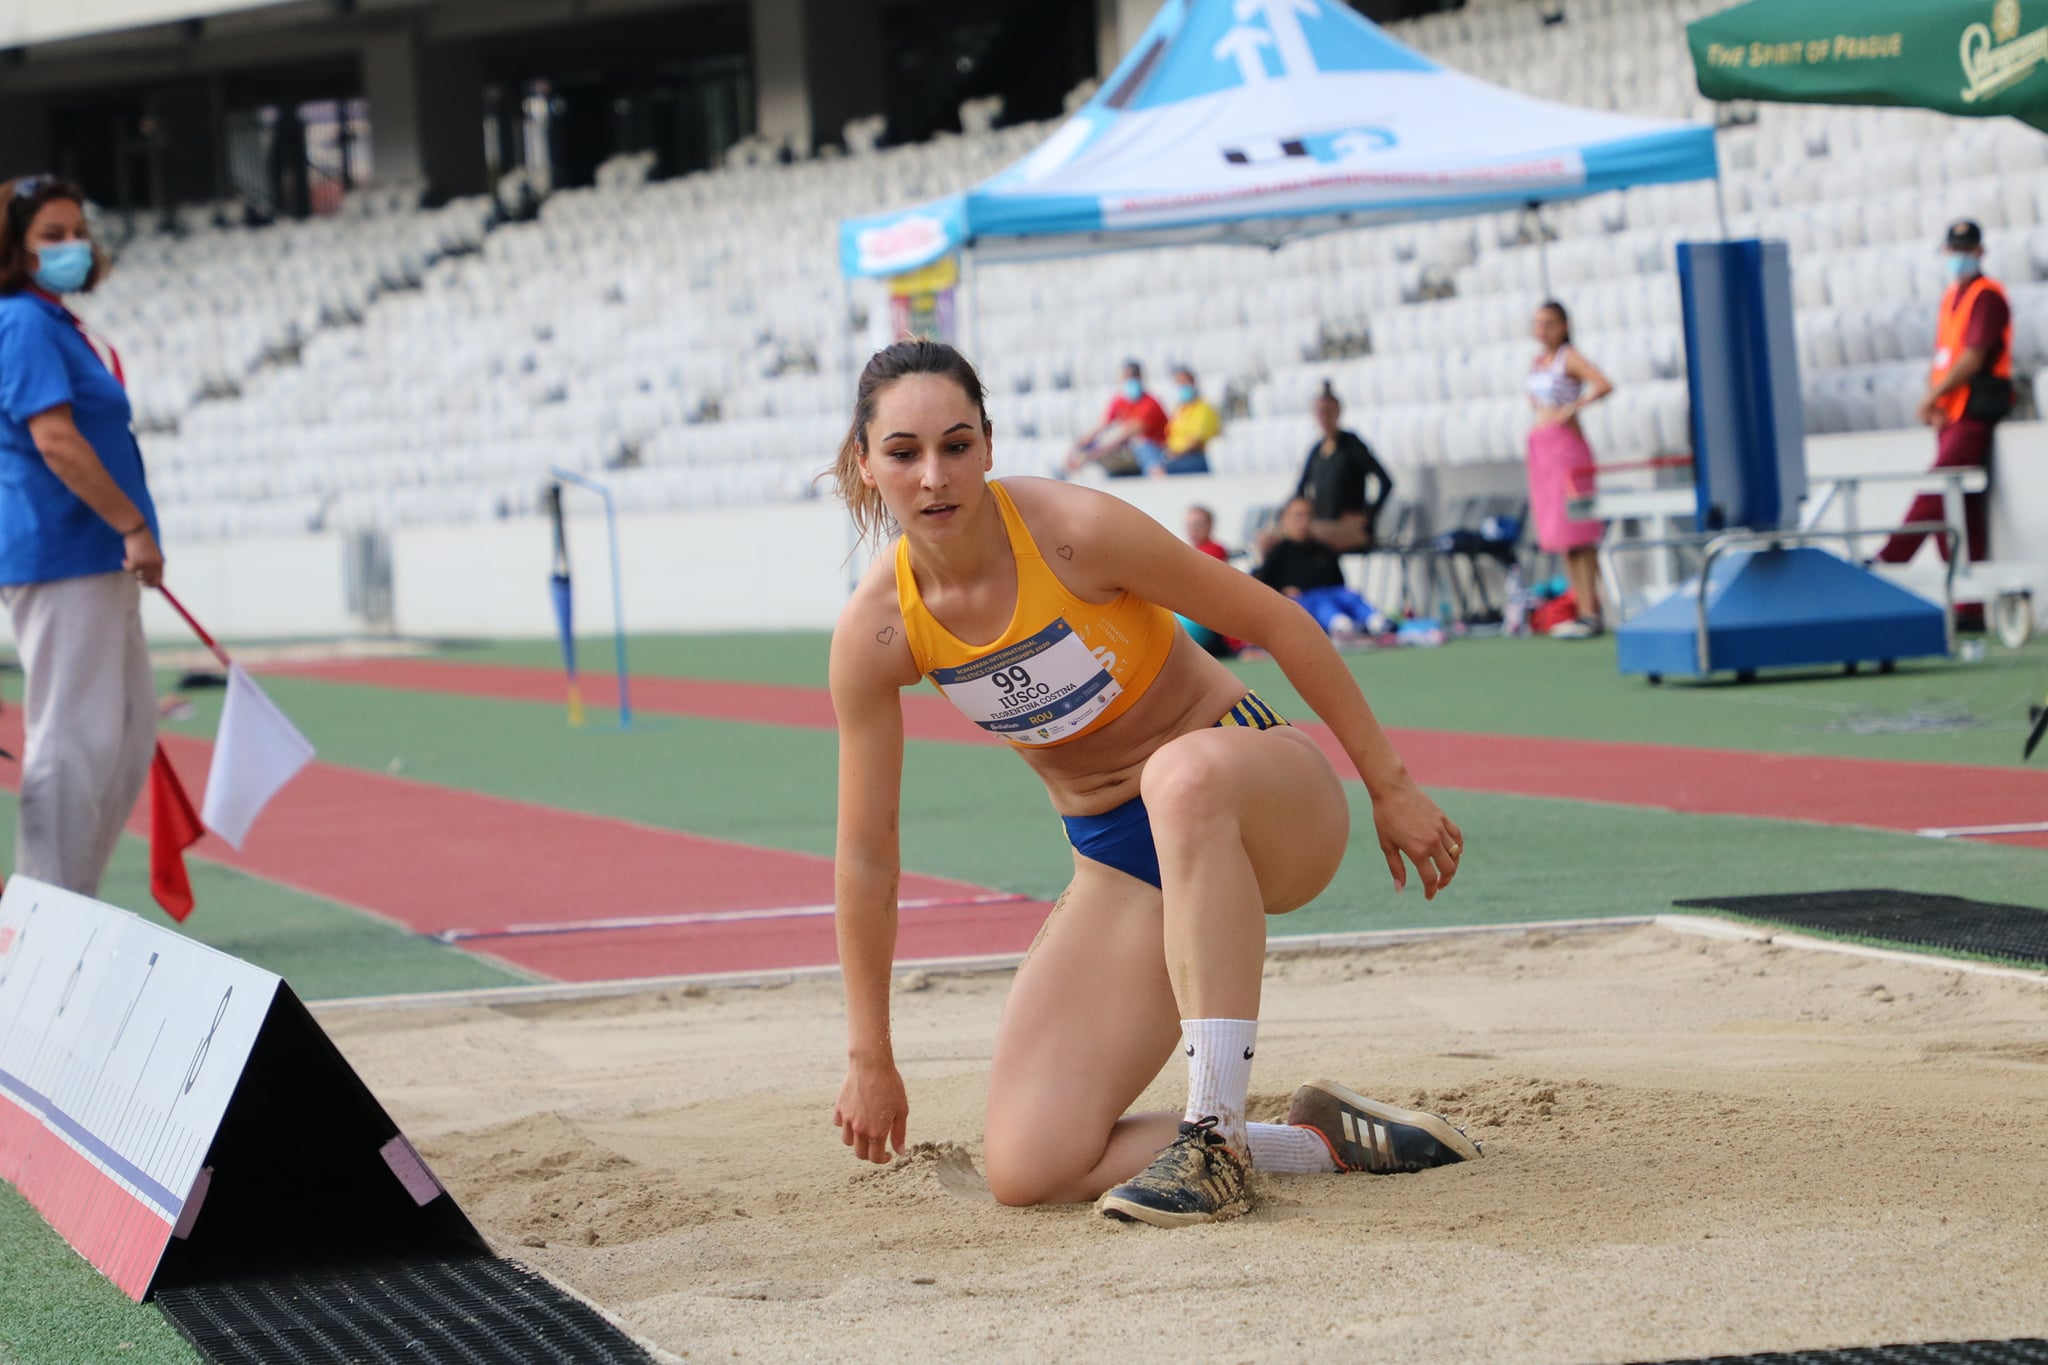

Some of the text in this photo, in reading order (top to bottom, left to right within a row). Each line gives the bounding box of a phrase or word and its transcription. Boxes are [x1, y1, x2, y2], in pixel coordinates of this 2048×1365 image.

[954, 640, 1051, 682] ATHLETICS CHAMPIONSHIPS 2020
[956, 640, 1038, 675] ROMANIAN INTERNATIONAL
[991, 665, 1032, 695] 99
[998, 682, 1050, 709] IUSCO
[990, 701, 1040, 720] FLORENTINA
[1039, 683, 1077, 705] COSTINA
[1028, 710, 1054, 725] ROU
